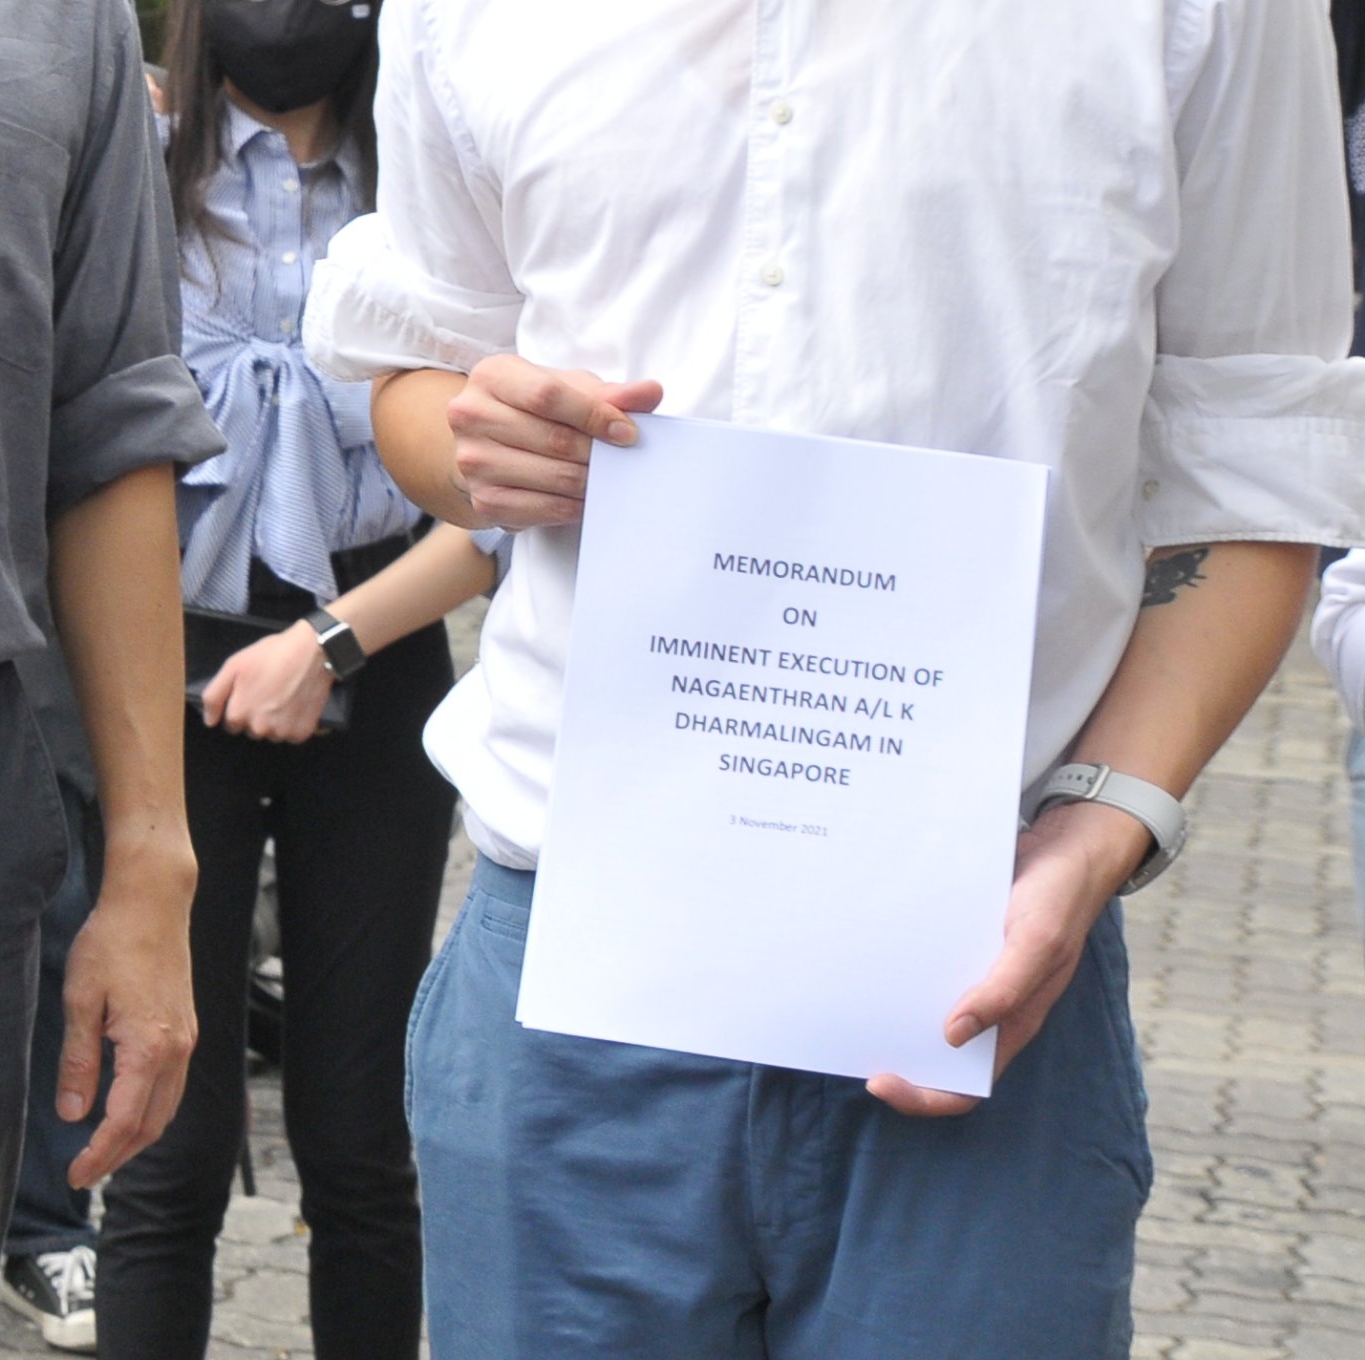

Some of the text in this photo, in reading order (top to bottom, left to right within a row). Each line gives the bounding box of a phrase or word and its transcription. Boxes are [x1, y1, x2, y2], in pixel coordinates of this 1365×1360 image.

[713, 552, 897, 592] MEMORANDUM
[783, 607, 818, 628] ON
[650, 635, 944, 688] IMMINENT EXECUTION OF
[671, 675, 915, 721] NAGAENTHRAN A/L K
[675, 712, 904, 756] DHARMALINGAM IN
[718, 753, 852, 786] SINGAPORE
[729, 814, 829, 837] 3 November 2021
